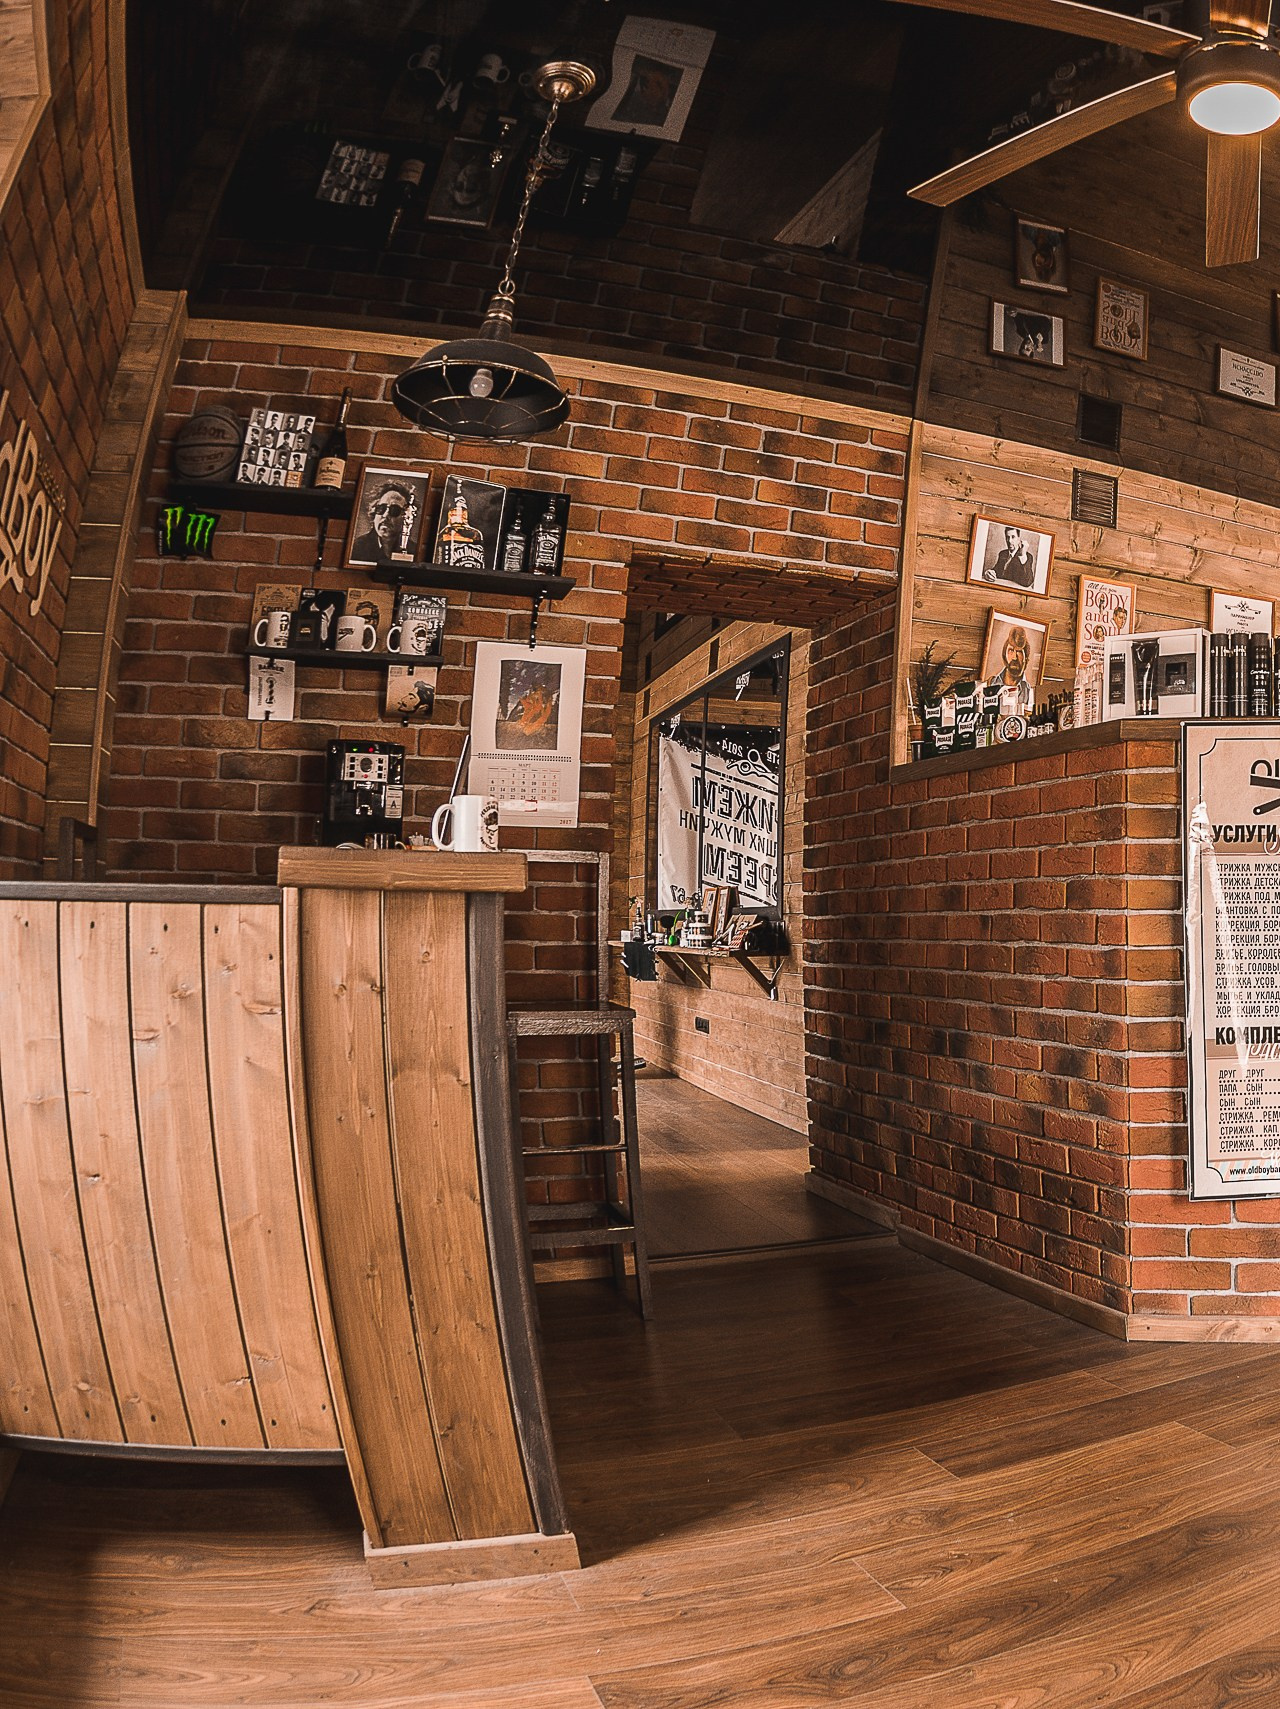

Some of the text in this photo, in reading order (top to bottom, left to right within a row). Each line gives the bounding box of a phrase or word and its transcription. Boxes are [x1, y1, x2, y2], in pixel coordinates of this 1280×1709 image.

[0, 412, 63, 616] dBoy
[1085, 589, 1129, 611] BODY
[1085, 611, 1109, 624] and
[1212, 824, 1277, 843] УСЛУГИ
[1218, 877, 1251, 887] ТРИЖКА
[1221, 891, 1251, 901] РИЖКА
[1254, 891, 1270, 901] ПОД
[1215, 905, 1259, 915] ОАНТОВКА
[1262, 905, 1268, 915] С
[1215, 934, 1260, 943] КОРРЕКЦИЯ
[1247, 962, 1280, 972] ГОЛОВЫ
[1216, 976, 1251, 986] СТРИЖКА
[1254, 976, 1275, 986] УСОВ
[1216, 991, 1243, 1000] МЫТЬЕ
[1246, 991, 1252, 1000] И
[1216, 1005, 1260, 1015] КОРЕКЦИЯ
[1219, 1069, 1236, 1079] ДРУГ
[1246, 1069, 1265, 1079] ДРУГ
[1219, 1083, 1238, 1093] ПАПА
[1246, 1083, 1263, 1093] СЫН
[1219, 1098, 1236, 1108] СЫН
[1244, 1097, 1261, 1106] СЫН
[1219, 1111, 1254, 1121] СТРИЖКА
[1220, 1125, 1254, 1136] СТРИЖКА
[1220, 1139, 1255, 1149] СТРИЖКА
